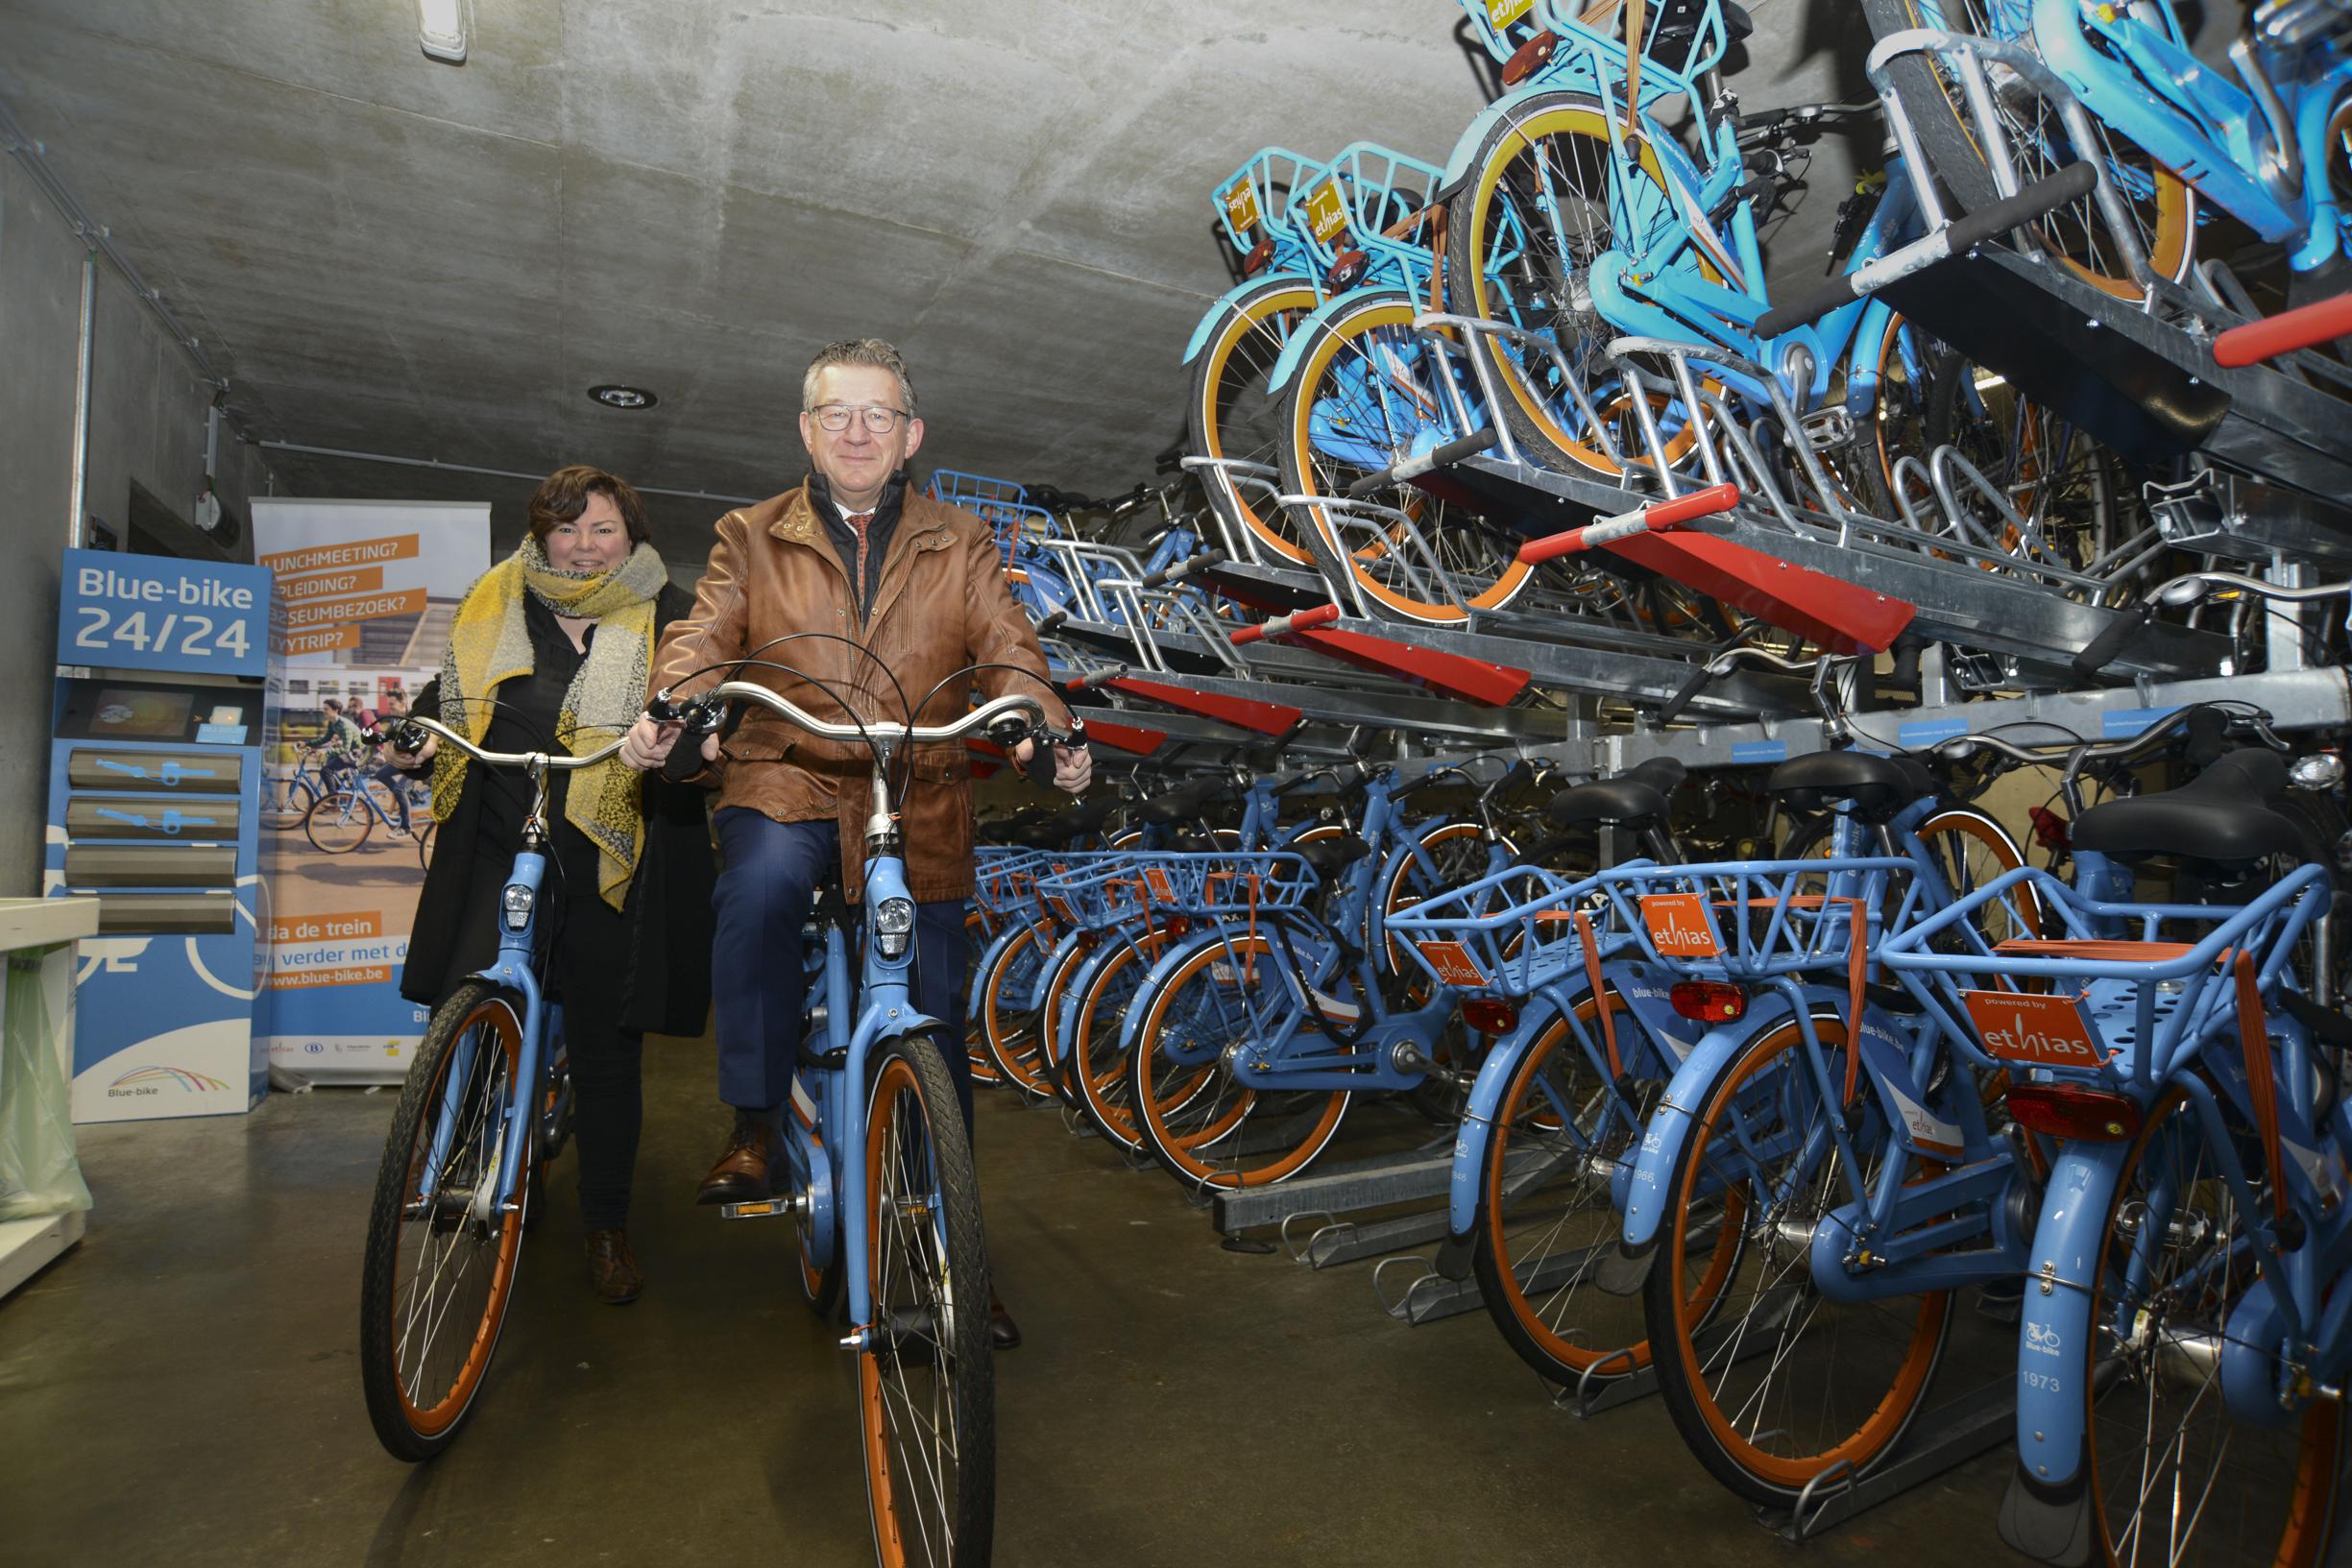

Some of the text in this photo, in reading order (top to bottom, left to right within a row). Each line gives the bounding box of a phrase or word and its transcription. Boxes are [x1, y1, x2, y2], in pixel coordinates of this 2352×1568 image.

[1315, 204, 1344, 237] ethias
[79, 568, 254, 610] Blue-bike
[76, 607, 251, 658] 24/24
[295, 922, 320, 939] de
[325, 919, 373, 937] trein
[1654, 911, 1711, 952] ethias
[282, 949, 345, 966] verder
[352, 945, 390, 961] met
[1437, 953, 1479, 981] ethias
[1984, 999, 2030, 1007] powered
[1984, 1013, 2090, 1057] ethias
[108, 1087, 158, 1098] Blue-bike
[2023, 1370, 2060, 1393] 1973
